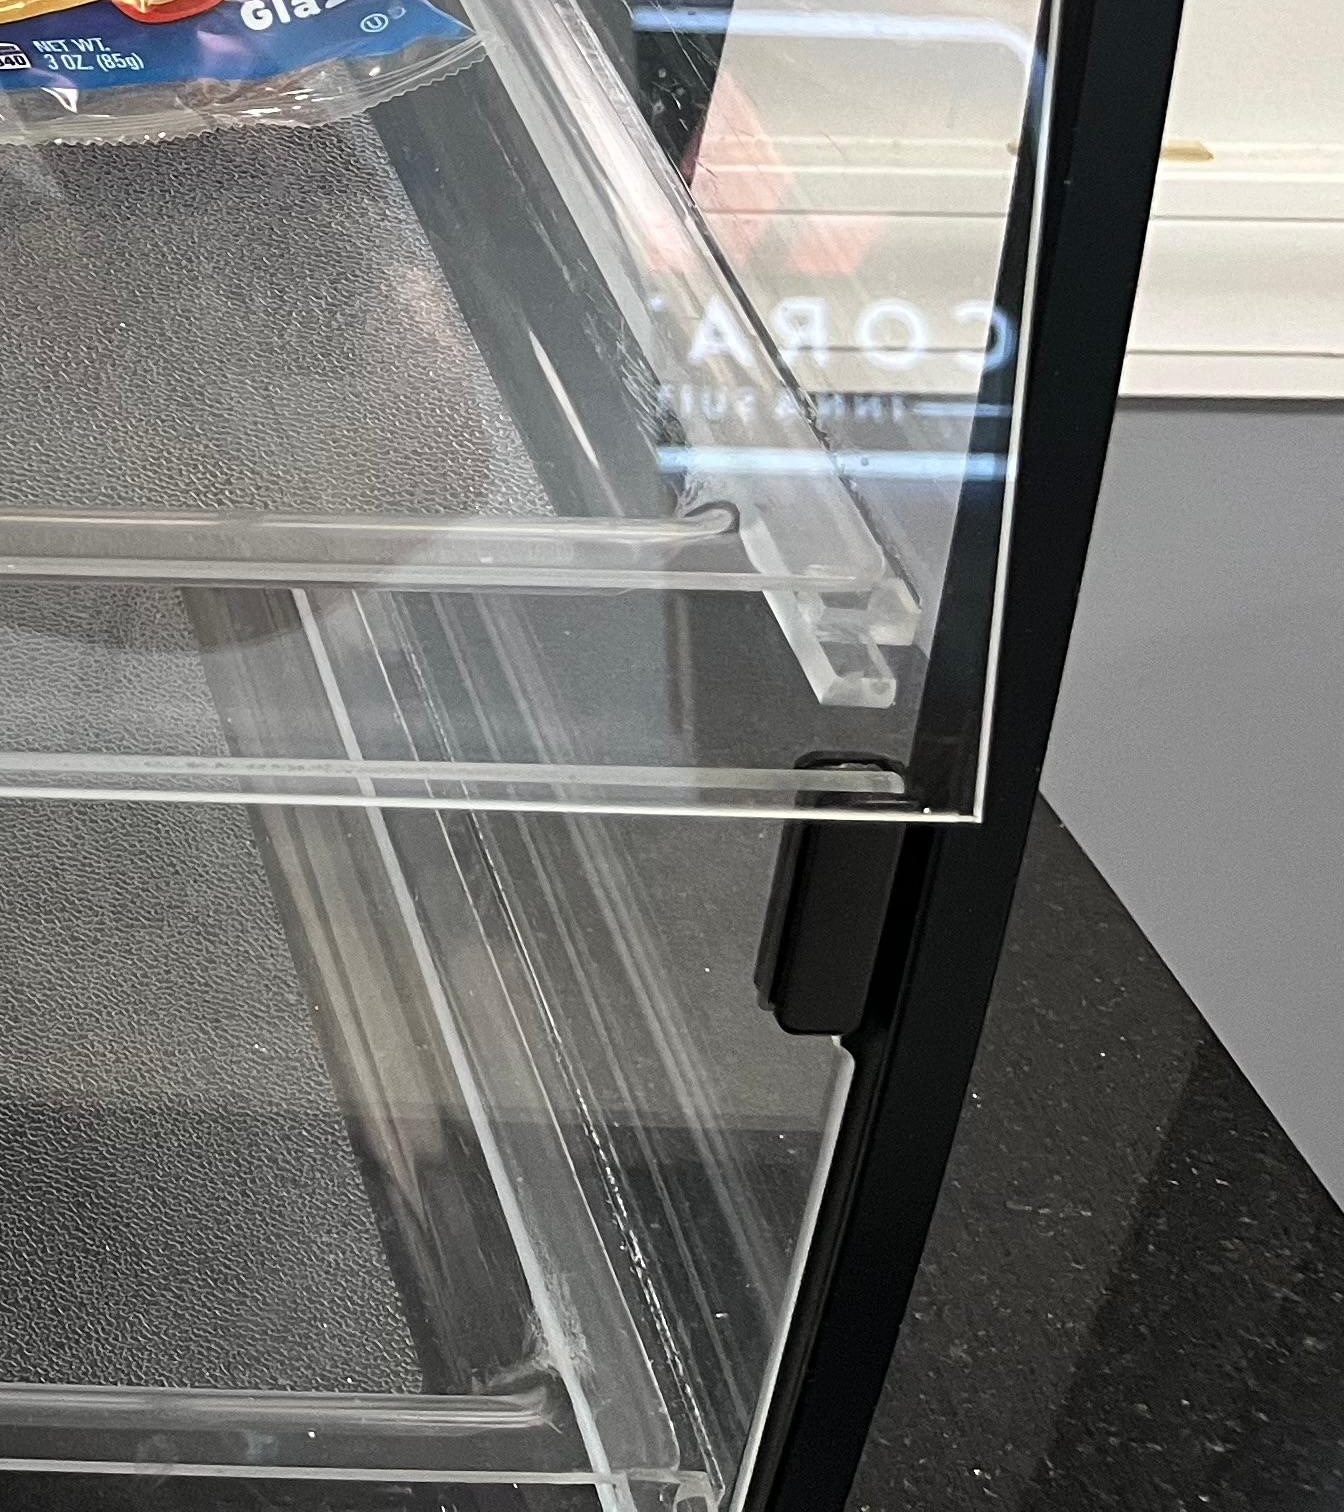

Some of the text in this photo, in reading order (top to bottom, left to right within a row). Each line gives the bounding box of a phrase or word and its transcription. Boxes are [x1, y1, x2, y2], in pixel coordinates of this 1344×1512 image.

[32, 39, 70, 53] NET
[72, 37, 111, 53] WT.
[44, 52, 145, 73] 3 OZ. (85g)
